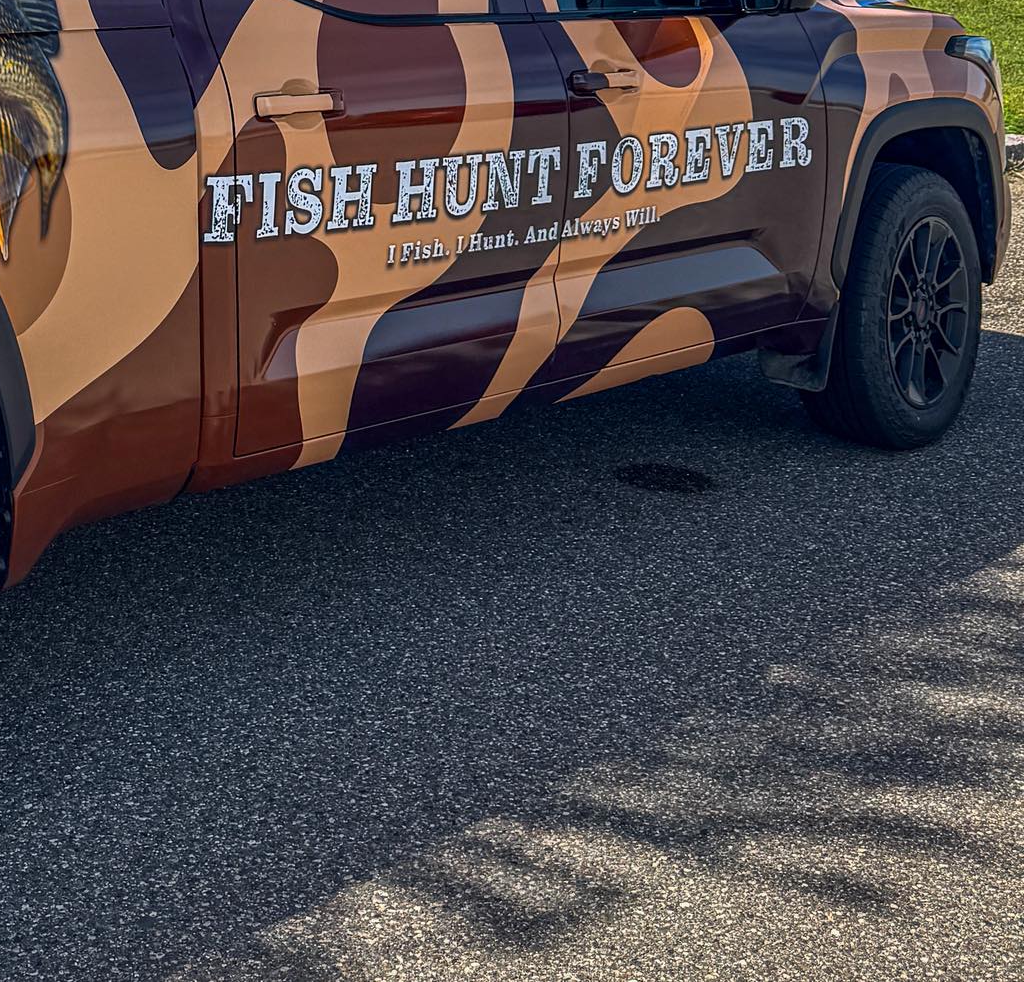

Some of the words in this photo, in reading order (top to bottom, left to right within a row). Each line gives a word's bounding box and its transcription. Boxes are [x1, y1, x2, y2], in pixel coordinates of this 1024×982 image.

[203, 163, 377, 242] FISH
[392, 146, 561, 222] HUNT
[573, 117, 813, 199] FOREVER
[387, 245, 395, 264] I
[400, 238, 450, 262] Fish.
[456, 235, 464, 254] I
[466, 232, 519, 253] Hunt.
[524, 223, 558, 244] And
[561, 215, 620, 237] Always
[625, 206, 661, 228] Will.
